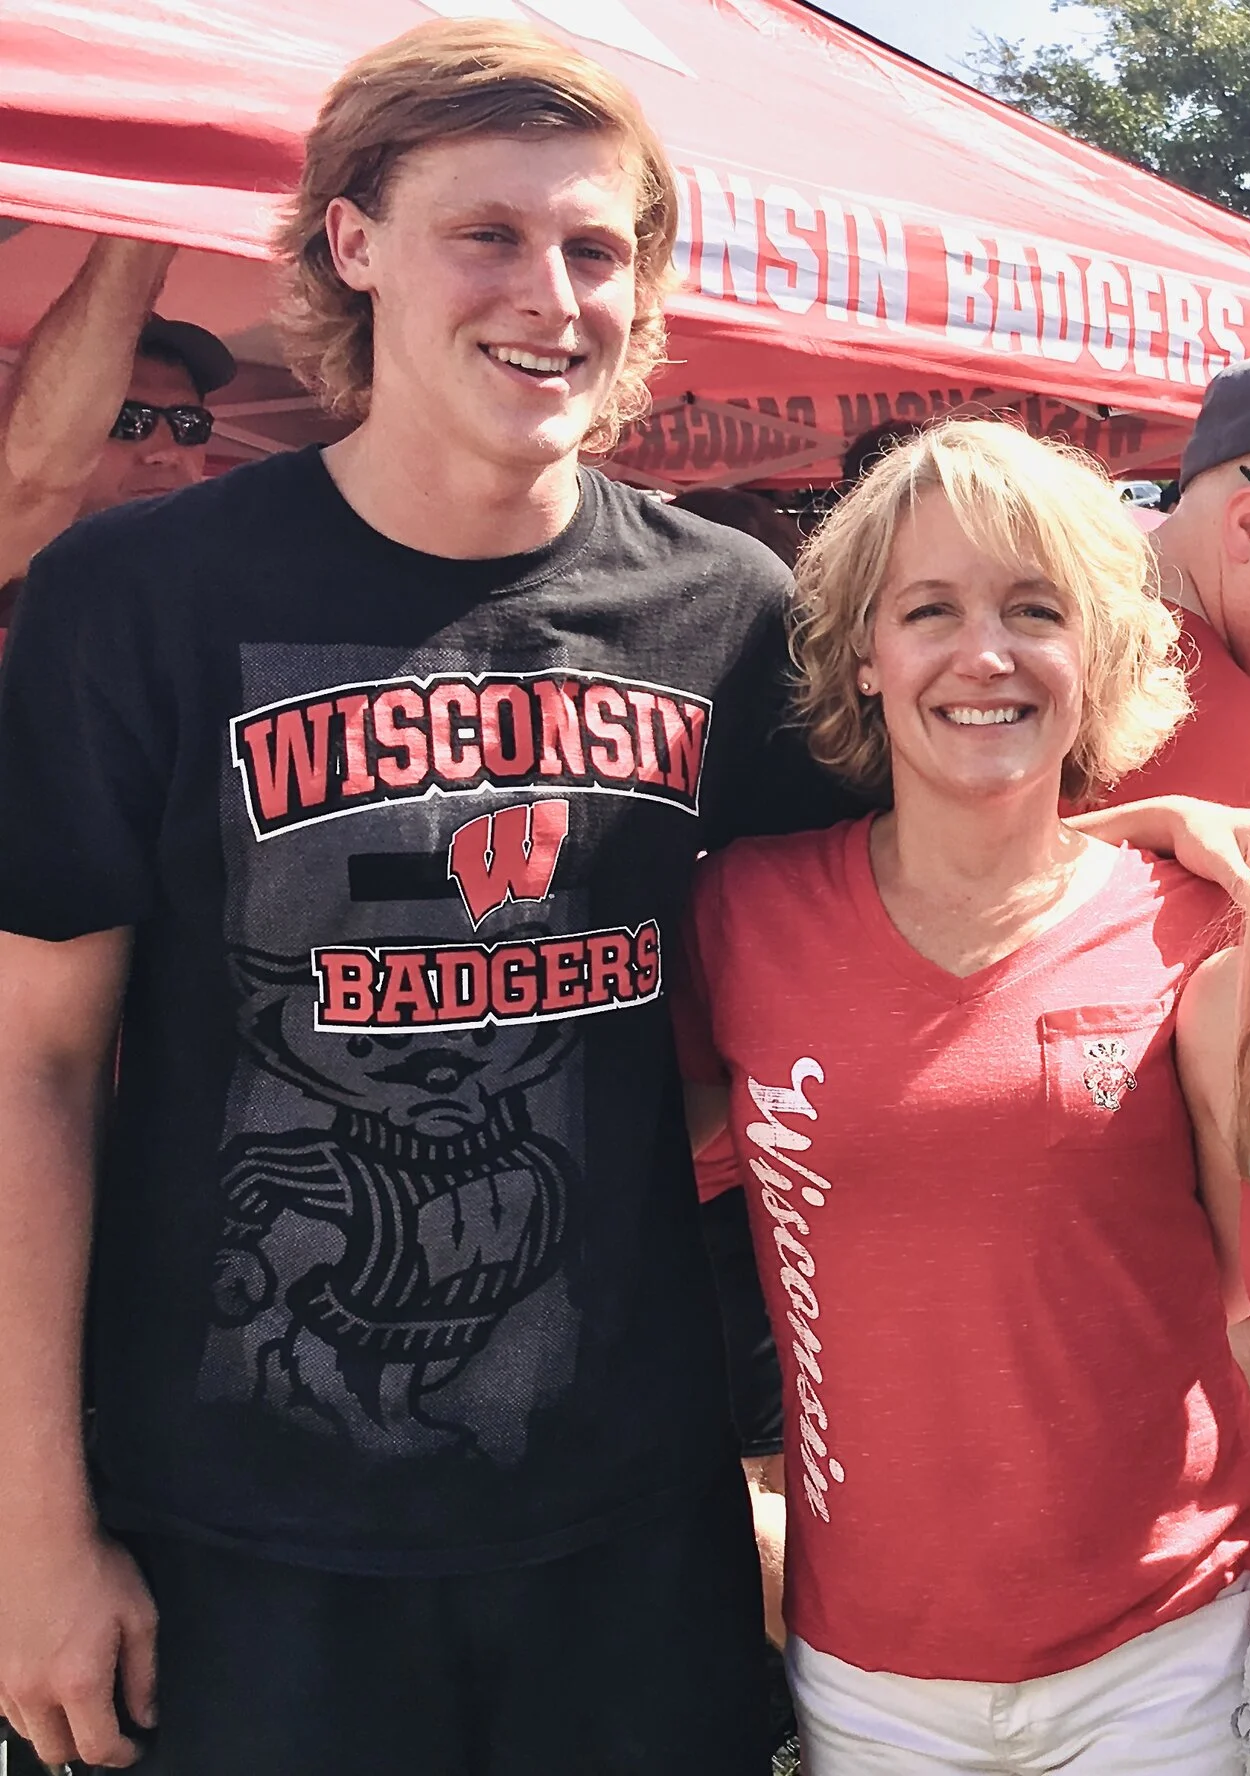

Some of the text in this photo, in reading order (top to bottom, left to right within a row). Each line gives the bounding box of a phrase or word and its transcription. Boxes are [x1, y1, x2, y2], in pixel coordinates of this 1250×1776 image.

[938, 226, 1245, 387] BADGERS
[238, 674, 708, 830] WISCONSIN
[447, 799, 569, 932] W
[313, 920, 661, 1031] BADGERS
[746, 1057, 847, 1524] Wisconsin
